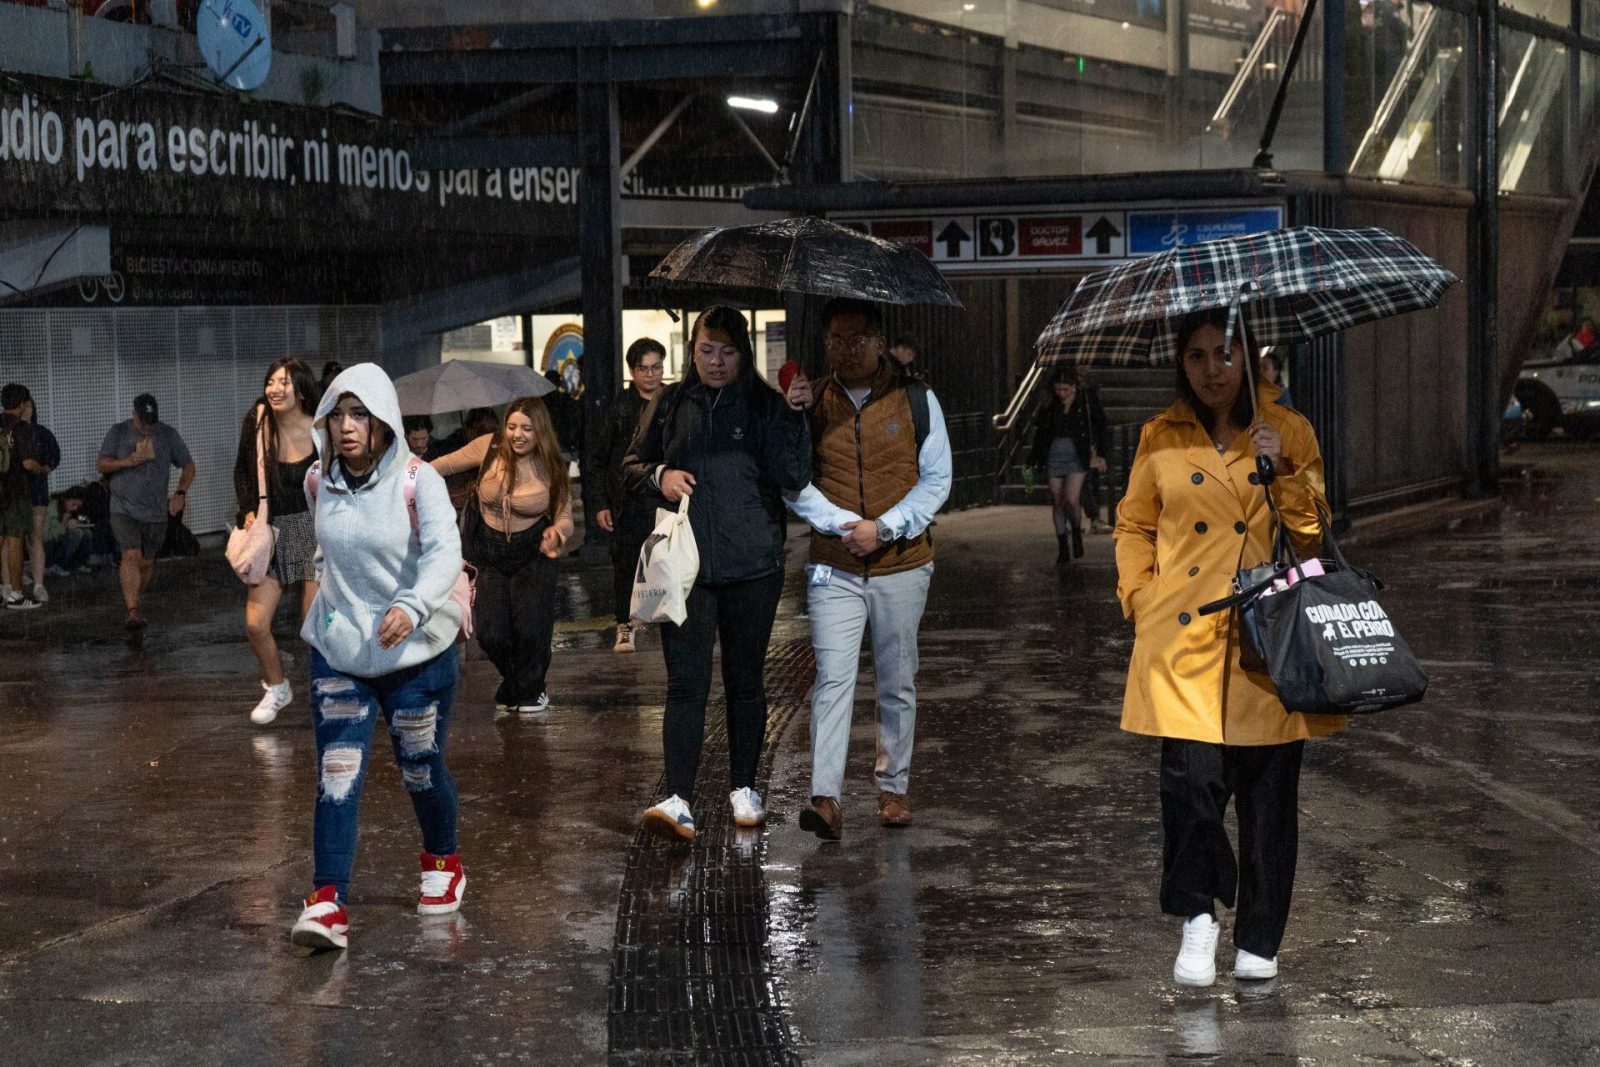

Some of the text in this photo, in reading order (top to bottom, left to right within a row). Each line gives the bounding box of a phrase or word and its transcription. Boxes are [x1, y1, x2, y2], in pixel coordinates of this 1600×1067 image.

[76, 117, 158, 182] para
[168, 119, 296, 186] escribir,
[303, 127, 330, 184] ni
[1305, 603, 1361, 624] CUIDADO
[1337, 619, 1395, 638] EL PERRO
